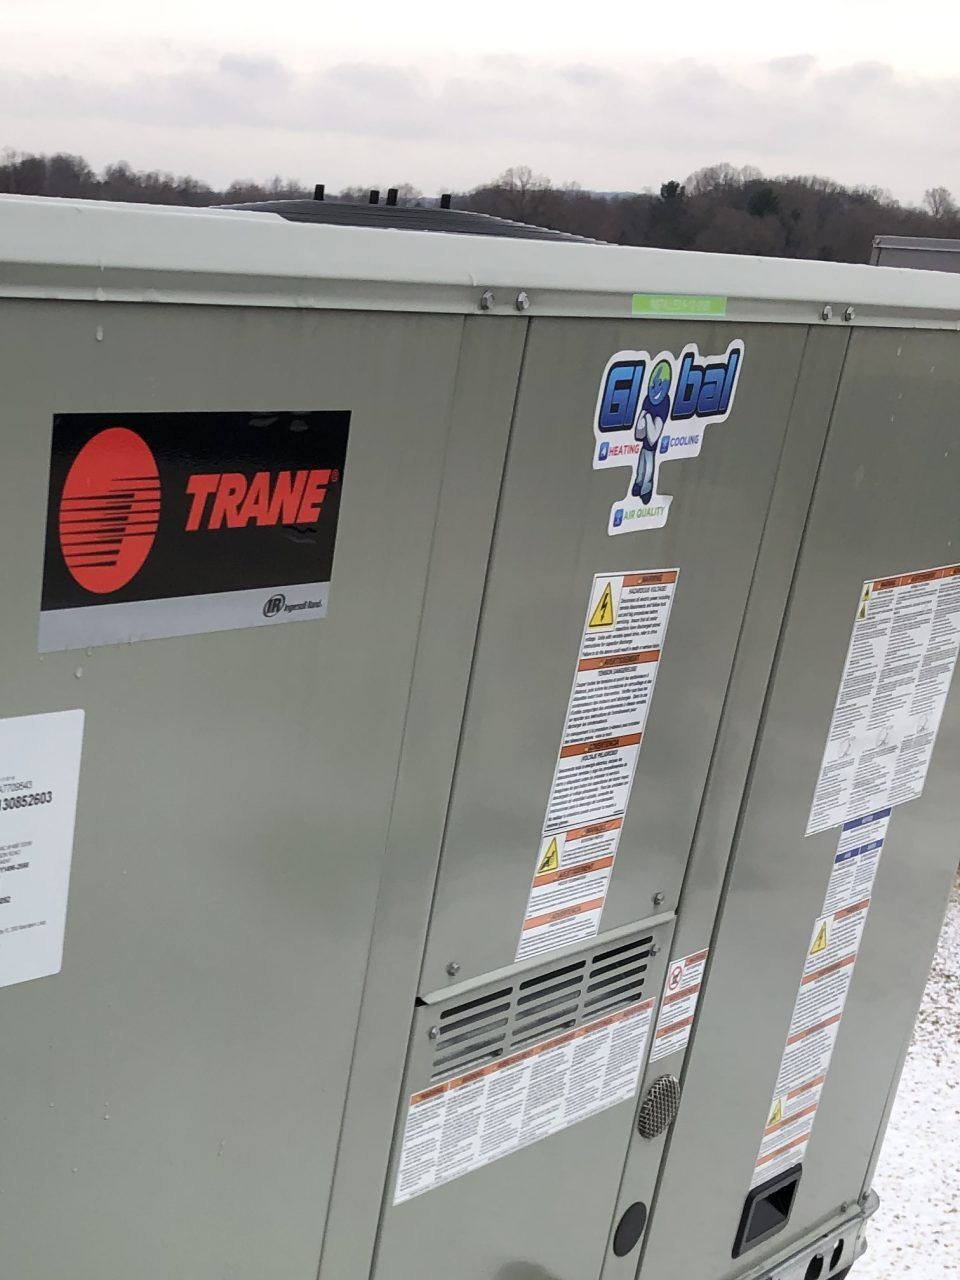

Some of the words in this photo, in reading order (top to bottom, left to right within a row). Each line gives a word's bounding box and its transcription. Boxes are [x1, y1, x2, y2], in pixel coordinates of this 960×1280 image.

[669, 434, 700, 448] COOLING
[608, 444, 640, 457] HEATING
[185, 469, 331, 532] TRANE
[623, 508, 636, 520] AIR
[636, 505, 665, 520] QUALITY
